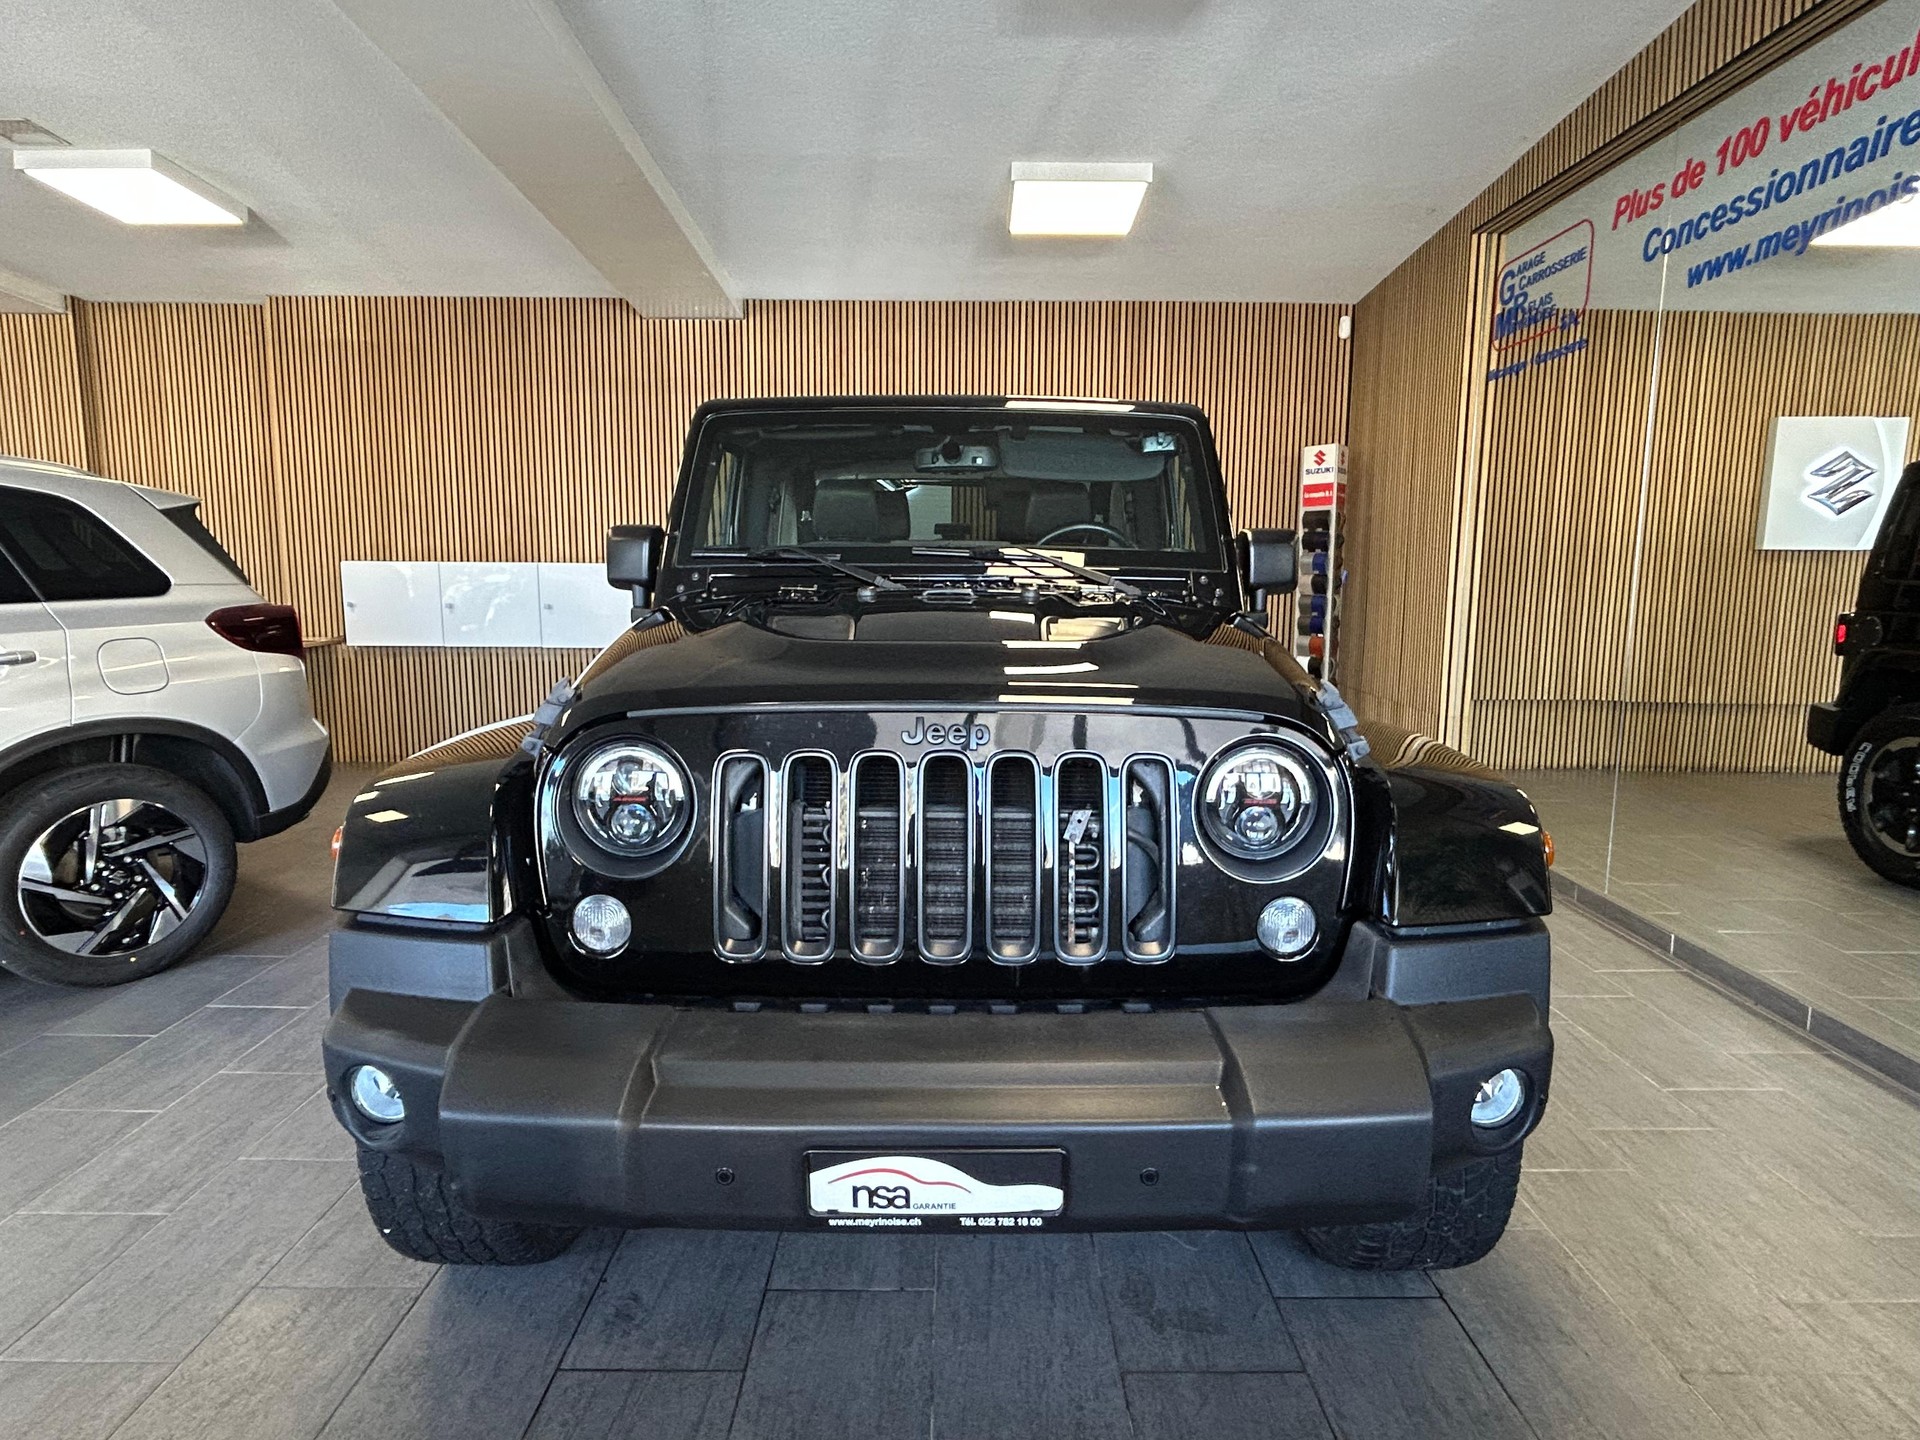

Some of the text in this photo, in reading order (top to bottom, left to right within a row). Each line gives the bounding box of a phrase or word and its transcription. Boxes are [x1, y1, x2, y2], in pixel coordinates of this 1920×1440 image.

[1611, 182, 1666, 231] Plus
[1671, 157, 1706, 199] de
[1716, 116, 1771, 176] 100
[1518, 246, 1588, 291] CARROSSERIE
[1305, 466, 1334, 475] SUZUKI
[901, 716, 990, 751] Jeep
[852, 1184, 911, 1210] nsa
[912, 1202, 957, 1210] GARANTIE
[978, 1217, 996, 1226] 022
[1030, 1217, 1043, 1226] 00
